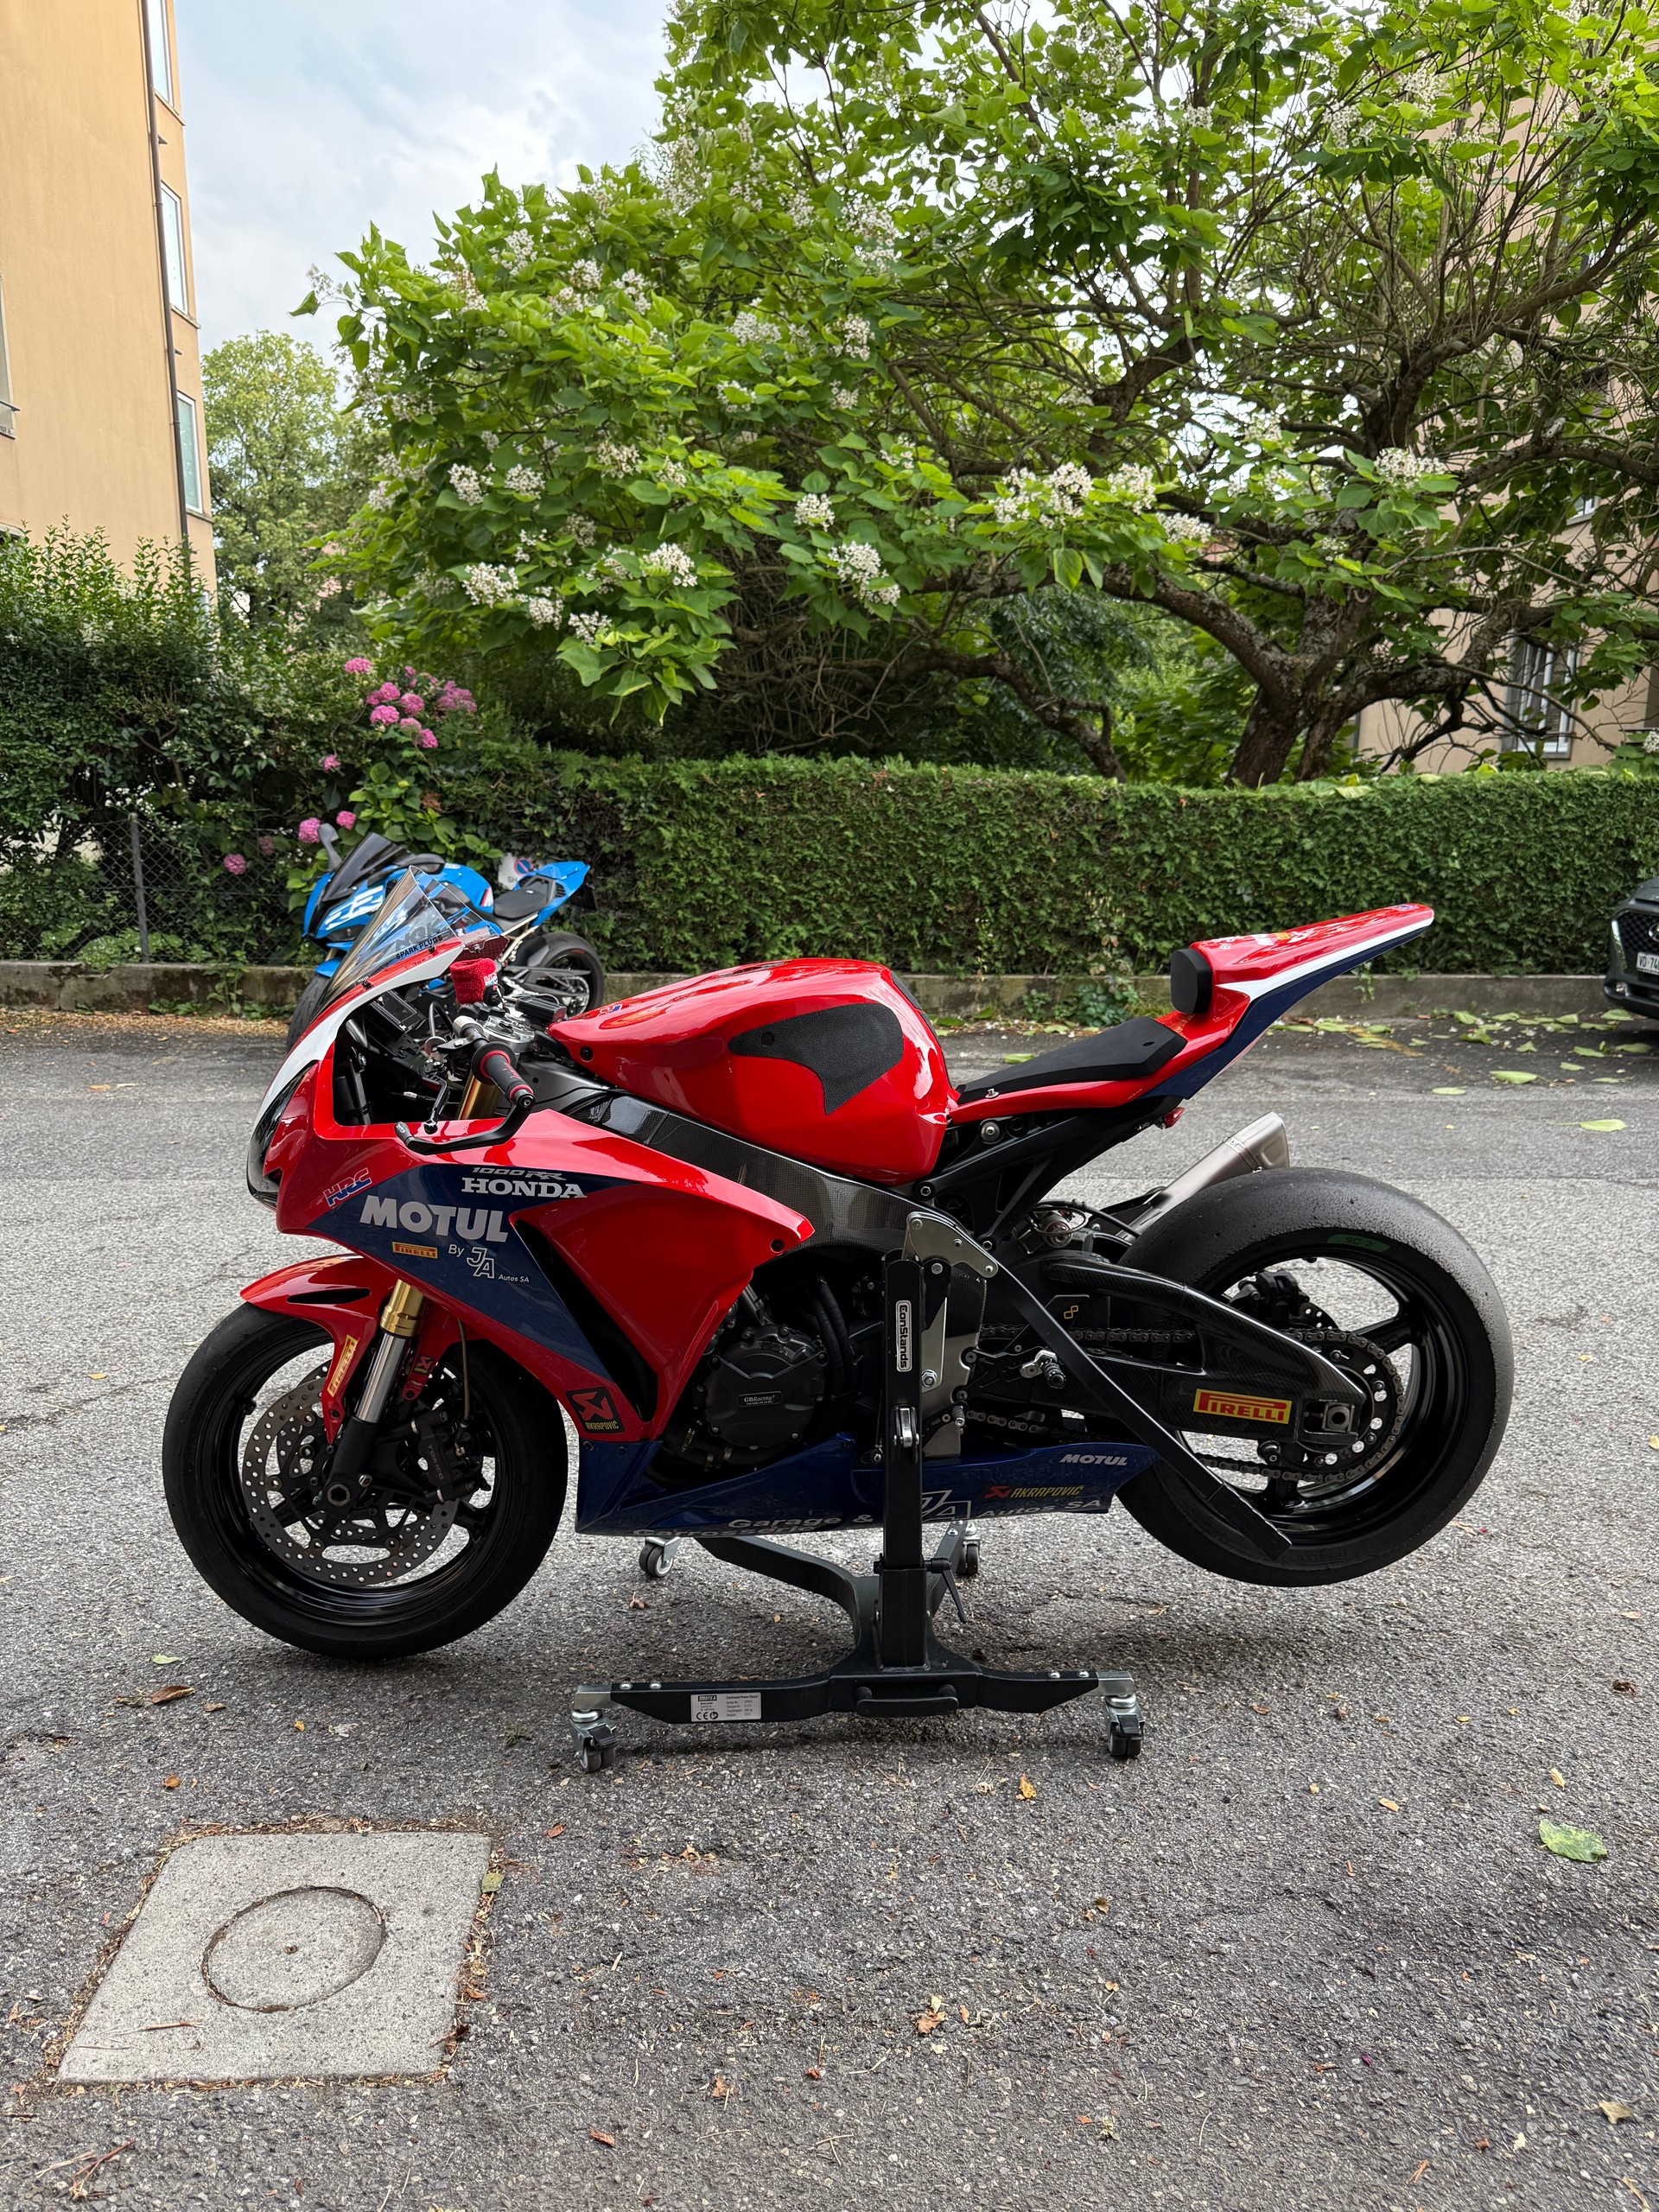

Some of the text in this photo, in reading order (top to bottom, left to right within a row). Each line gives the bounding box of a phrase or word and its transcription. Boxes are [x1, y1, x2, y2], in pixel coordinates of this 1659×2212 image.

[395, 919, 444, 950] NGK
[396, 935, 443, 959] SPARK PLUGS
[323, 1167, 372, 1207] HRC
[461, 1177, 587, 1198] HONDA
[359, 1195, 508, 1243] MOTUL
[393, 1243, 437, 1258] PIRELLI
[448, 1244, 465, 1257] By
[499, 1274, 518, 1282] Autos
[1198, 1392, 1287, 1421] PIRELLI
[1059, 1454, 1128, 1465] MOTUL
[728, 1516, 842, 1528] Garage
[852, 1514, 874, 1523] &
[976, 1505, 1055, 1519] Autos
[1065, 1500, 1101, 1509] SA
